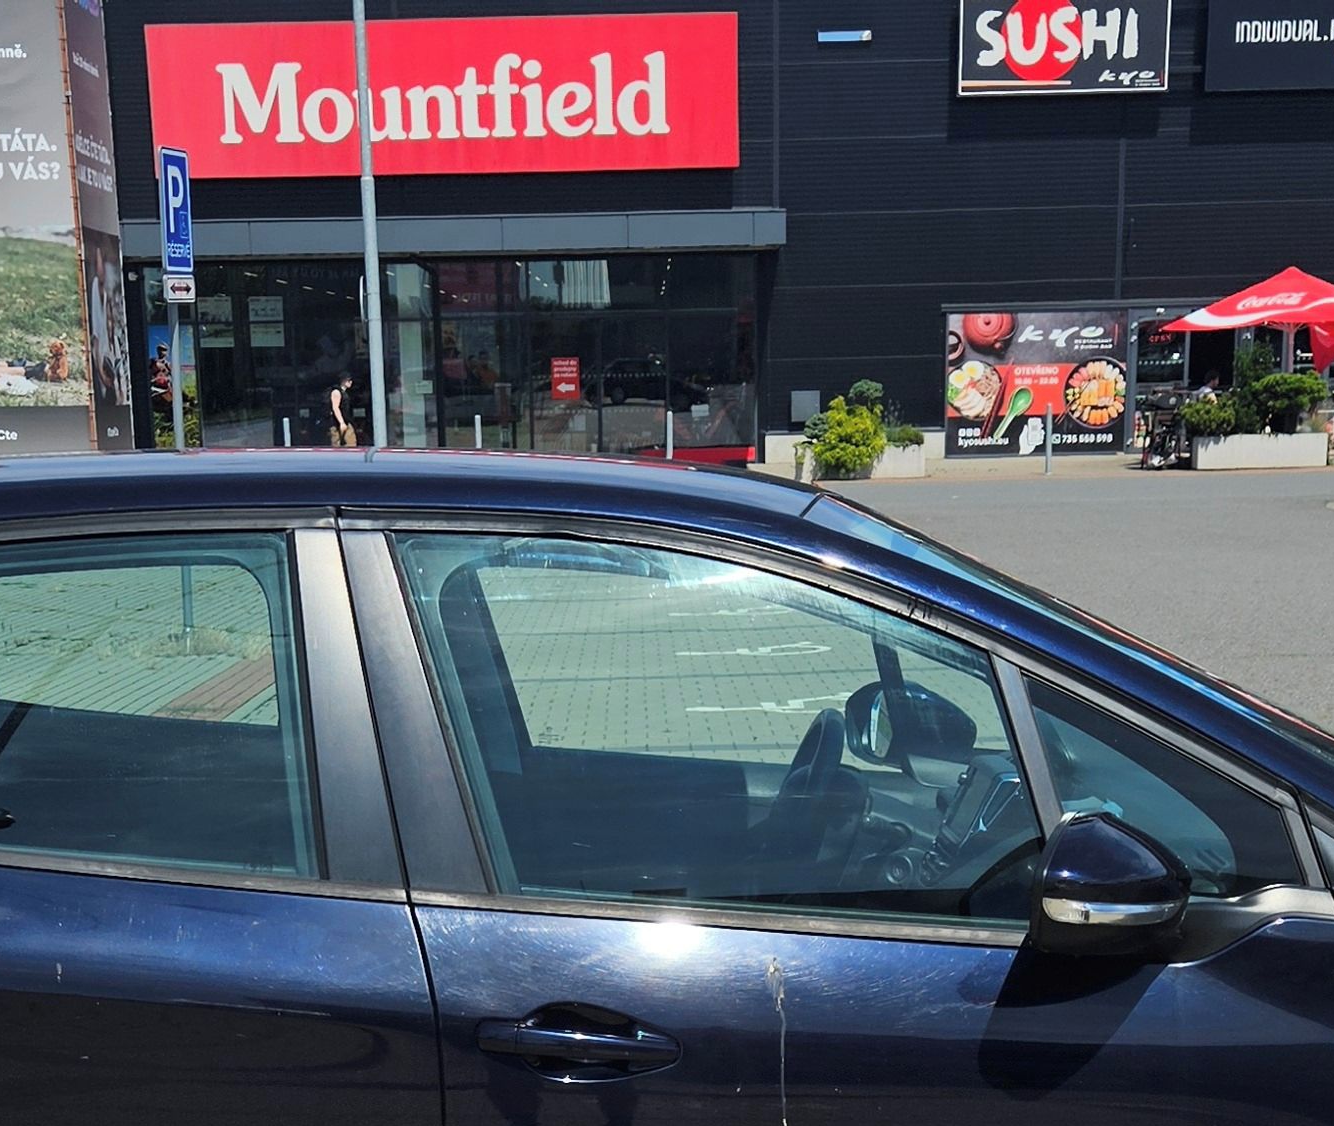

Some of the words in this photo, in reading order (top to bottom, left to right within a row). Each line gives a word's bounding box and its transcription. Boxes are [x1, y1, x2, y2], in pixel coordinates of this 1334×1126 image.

[975, 6, 1139, 66] SUSHI
[215, 51, 670, 145] Mountfield
[1099, 69, 1155, 85] kyo
[8, 156, 61, 181] VÁS?
[167, 164, 185, 233] P
[1018, 325, 1104, 347] kyo
